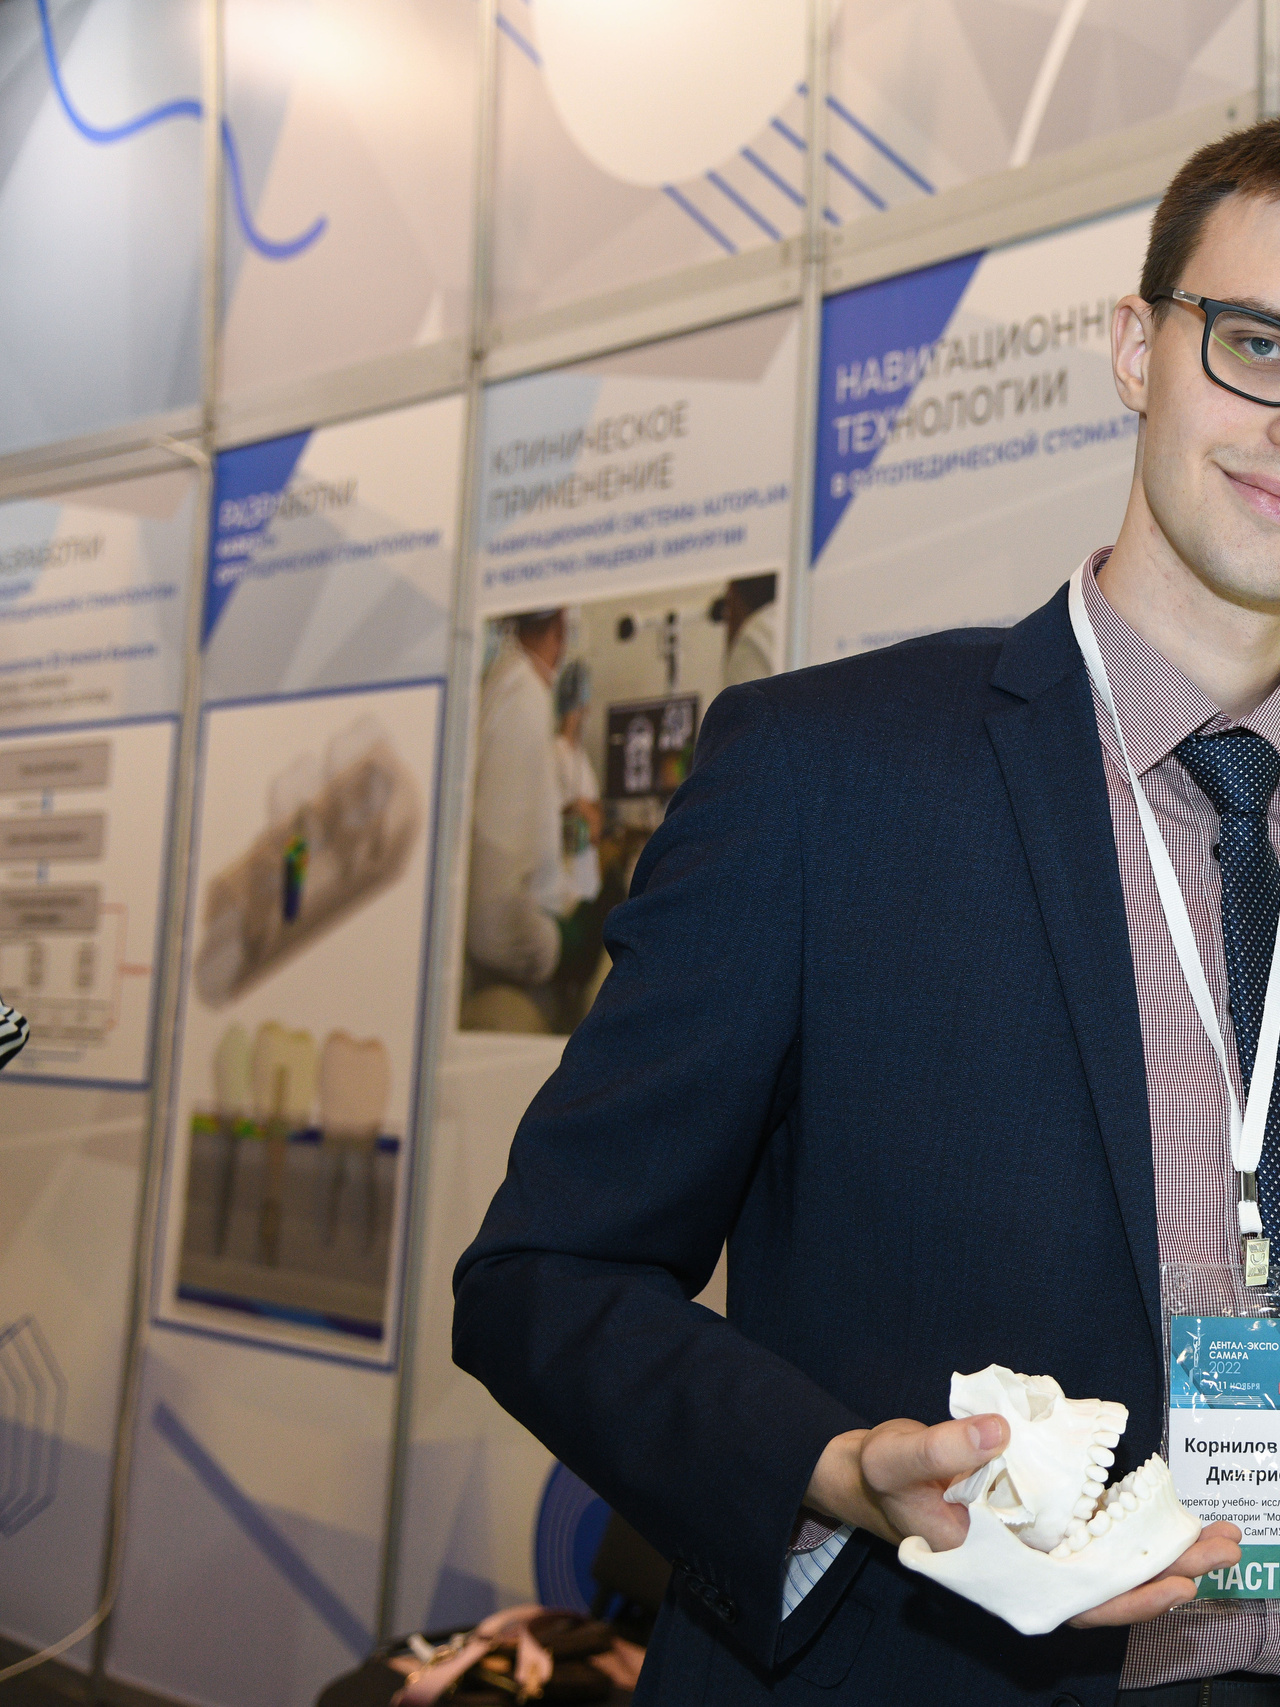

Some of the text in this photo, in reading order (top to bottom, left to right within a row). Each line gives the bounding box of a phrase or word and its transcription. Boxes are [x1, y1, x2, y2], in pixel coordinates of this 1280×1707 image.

[834, 296, 1116, 404] НАВИГАЦИОНН
[833, 368, 1070, 456] ТЕХНОЛОГИИ
[493, 400, 689, 476] КЛИНИЧЕСКОЕ
[487, 451, 674, 522] ПРИМЕНЕНИЕ
[1209, 1341, 1280, 1351] ДЕНТАЛ-ЭКСПО
[1209, 1350, 1249, 1360] САМАРА
[1209, 1361, 1242, 1374] 2022
[1230, 1382, 1261, 1391] НОЯБРЯ
[1184, 1437, 1278, 1456] Корнилов
